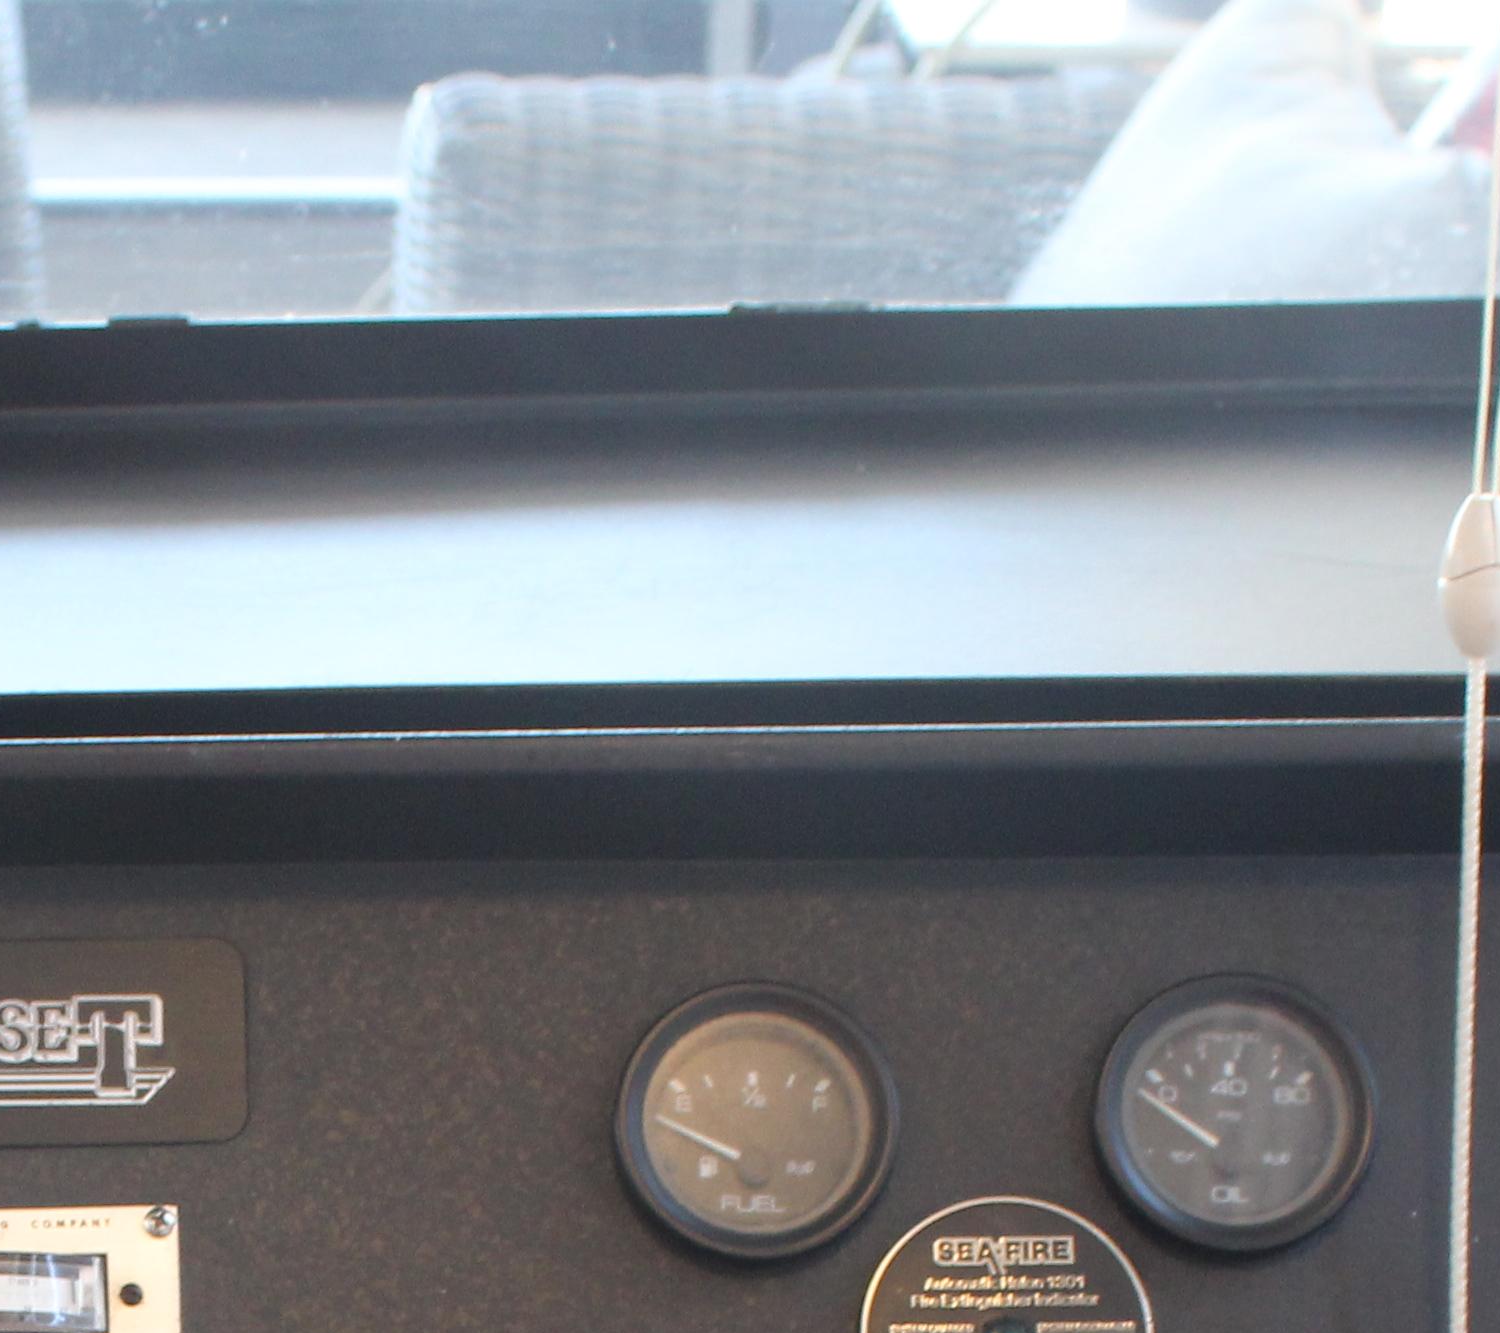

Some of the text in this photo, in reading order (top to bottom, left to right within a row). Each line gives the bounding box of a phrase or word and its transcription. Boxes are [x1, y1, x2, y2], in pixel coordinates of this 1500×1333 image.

[1211, 1078, 1247, 1096] 40
[721, 1195, 787, 1212] FUEL
[31, 1218, 111, 1229] COMPANY
[1046, 1274, 1086, 1290] 1301
